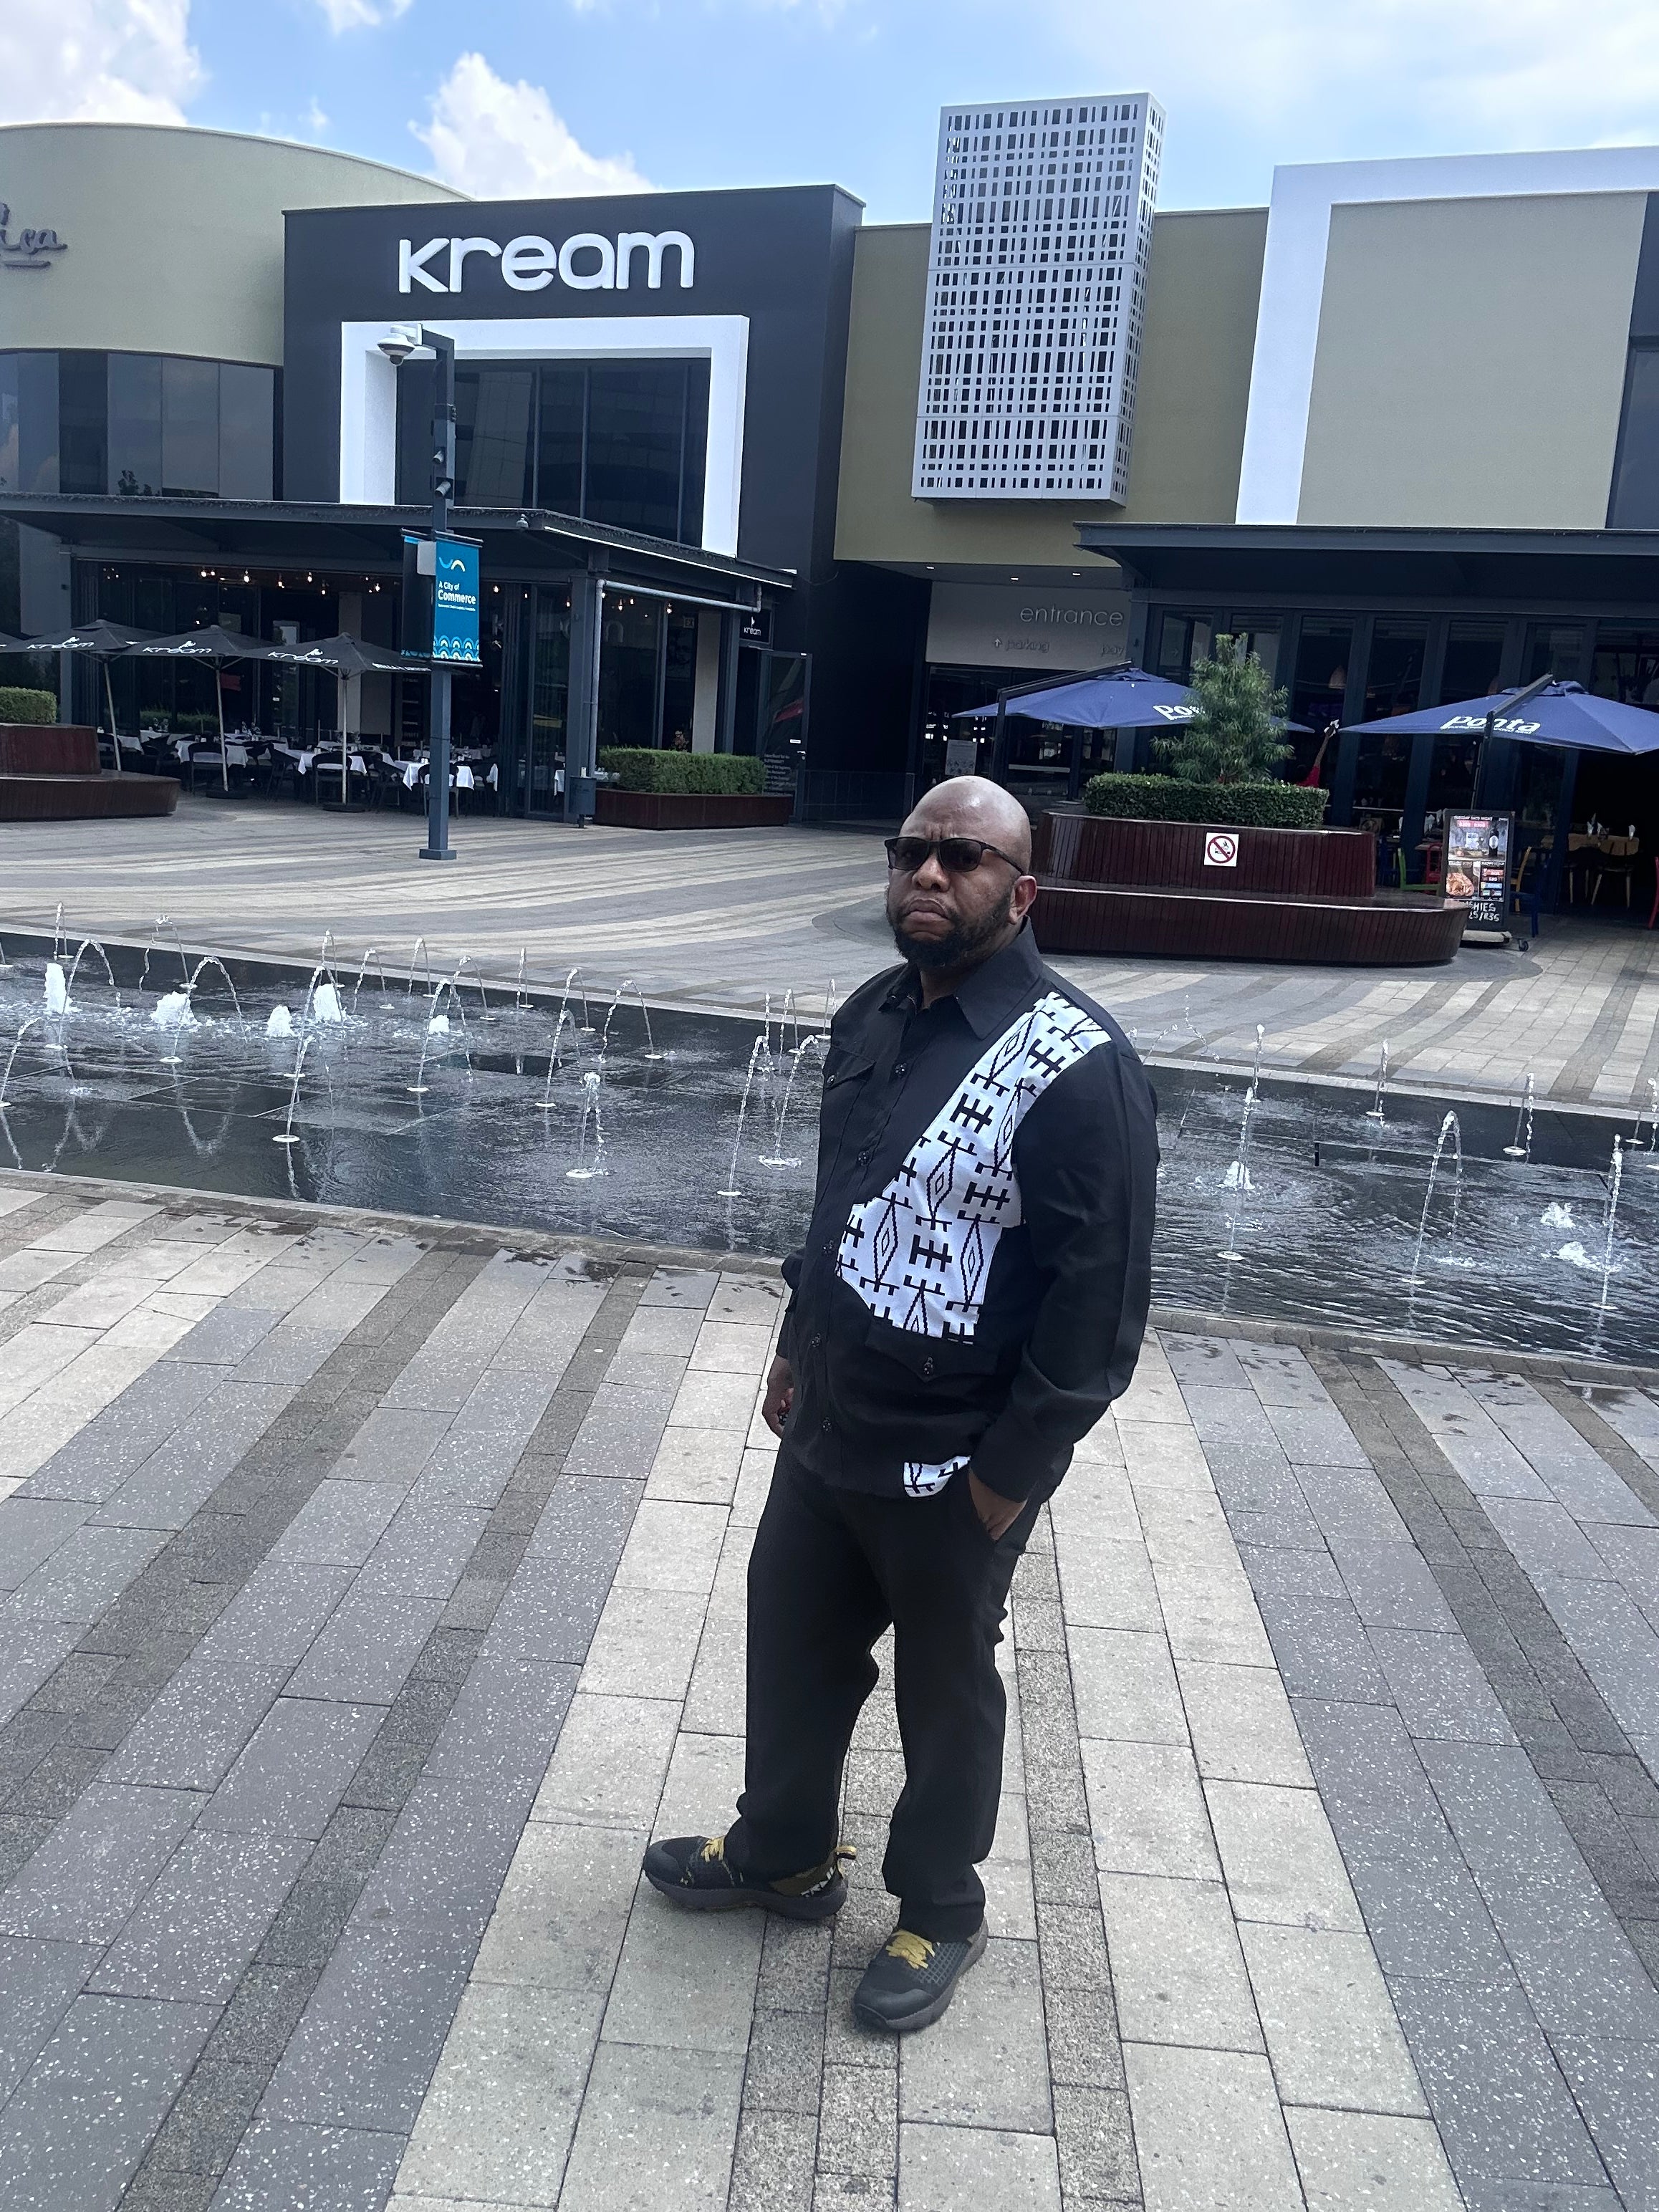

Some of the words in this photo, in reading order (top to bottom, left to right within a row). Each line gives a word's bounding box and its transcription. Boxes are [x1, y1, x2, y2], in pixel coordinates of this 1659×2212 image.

[443, 581, 454, 591] City
[438, 589, 476, 605] Commerce
[1019, 603, 1123, 626] entrance
[1006, 639, 1050, 653] parking
[1101, 646, 1125, 657] pay
